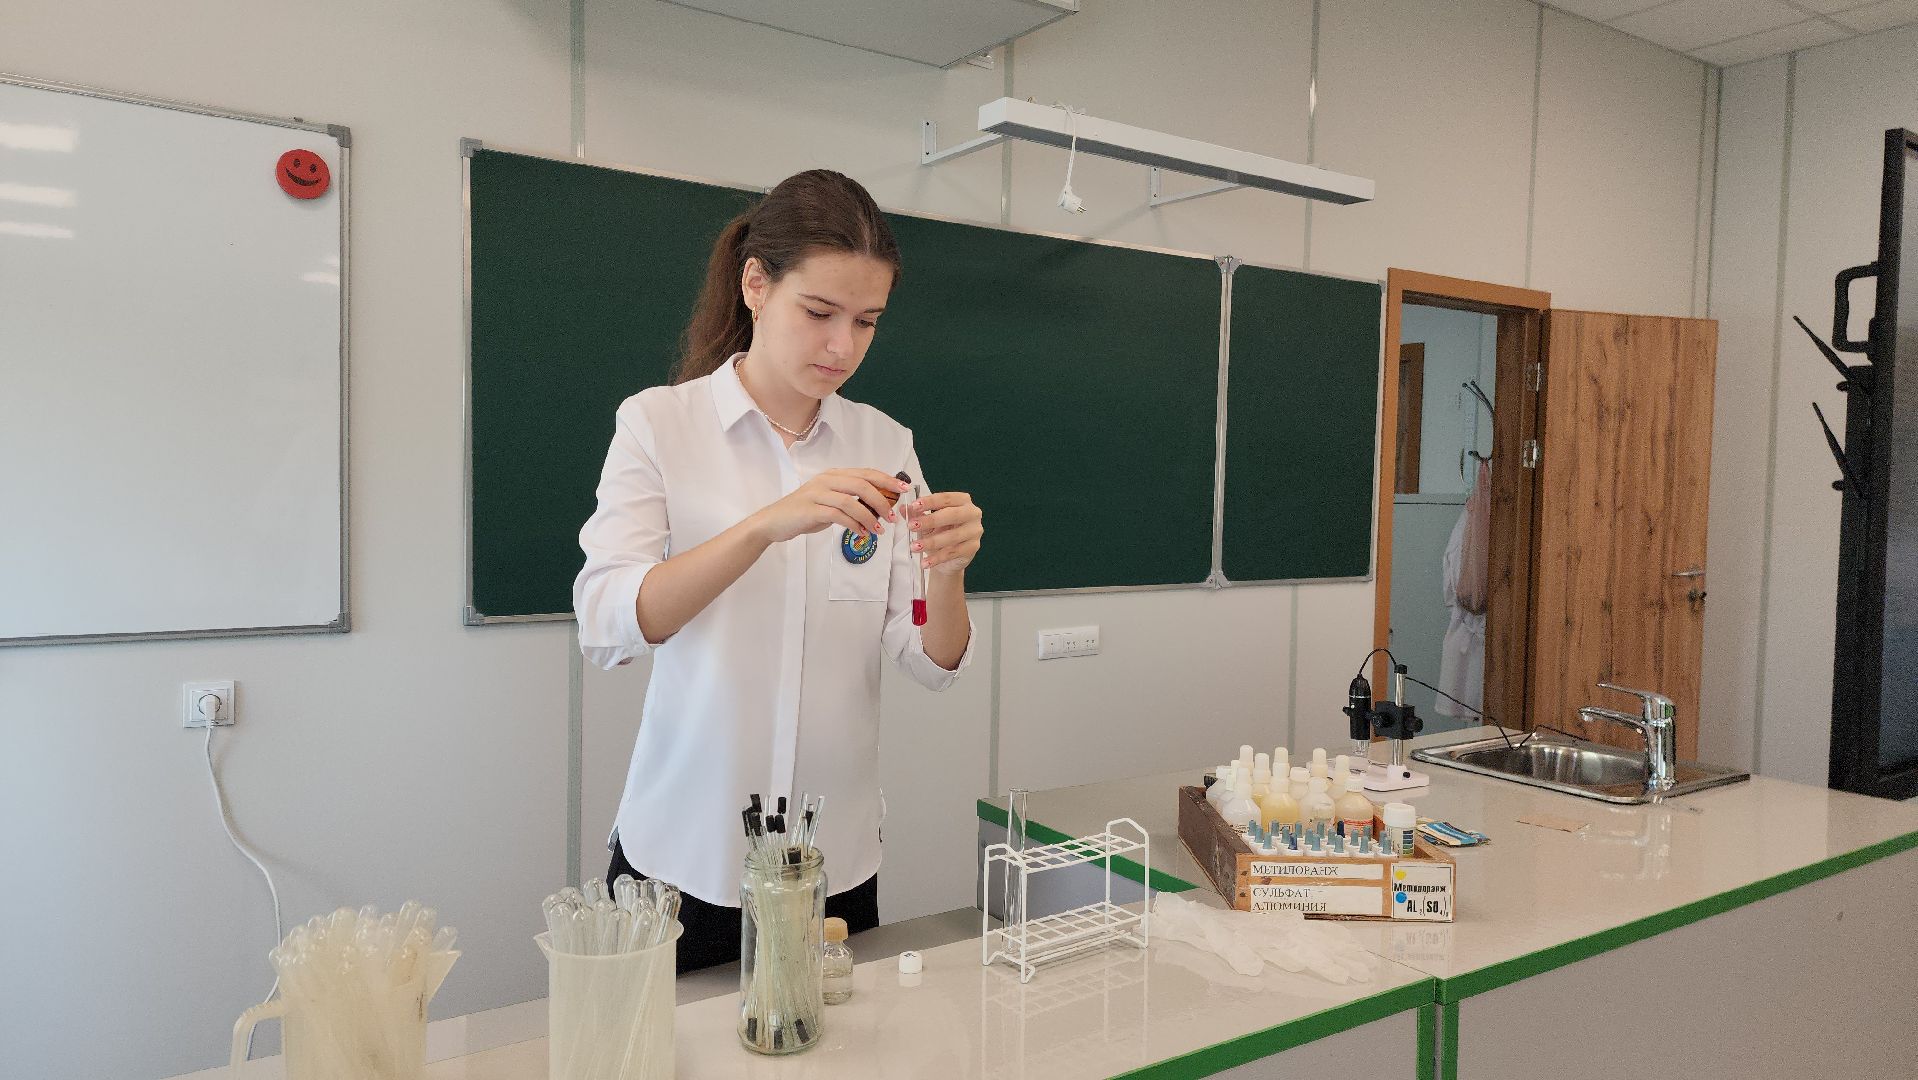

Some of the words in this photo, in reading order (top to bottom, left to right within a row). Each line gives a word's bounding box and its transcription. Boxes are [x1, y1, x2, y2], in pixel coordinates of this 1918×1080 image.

[1252, 864, 1339, 876] МЕТИЛОРАНЖ
[1252, 887, 1311, 898] СУЛЬФАТ
[1252, 901, 1327, 912] АЛЮМИНИЯ
